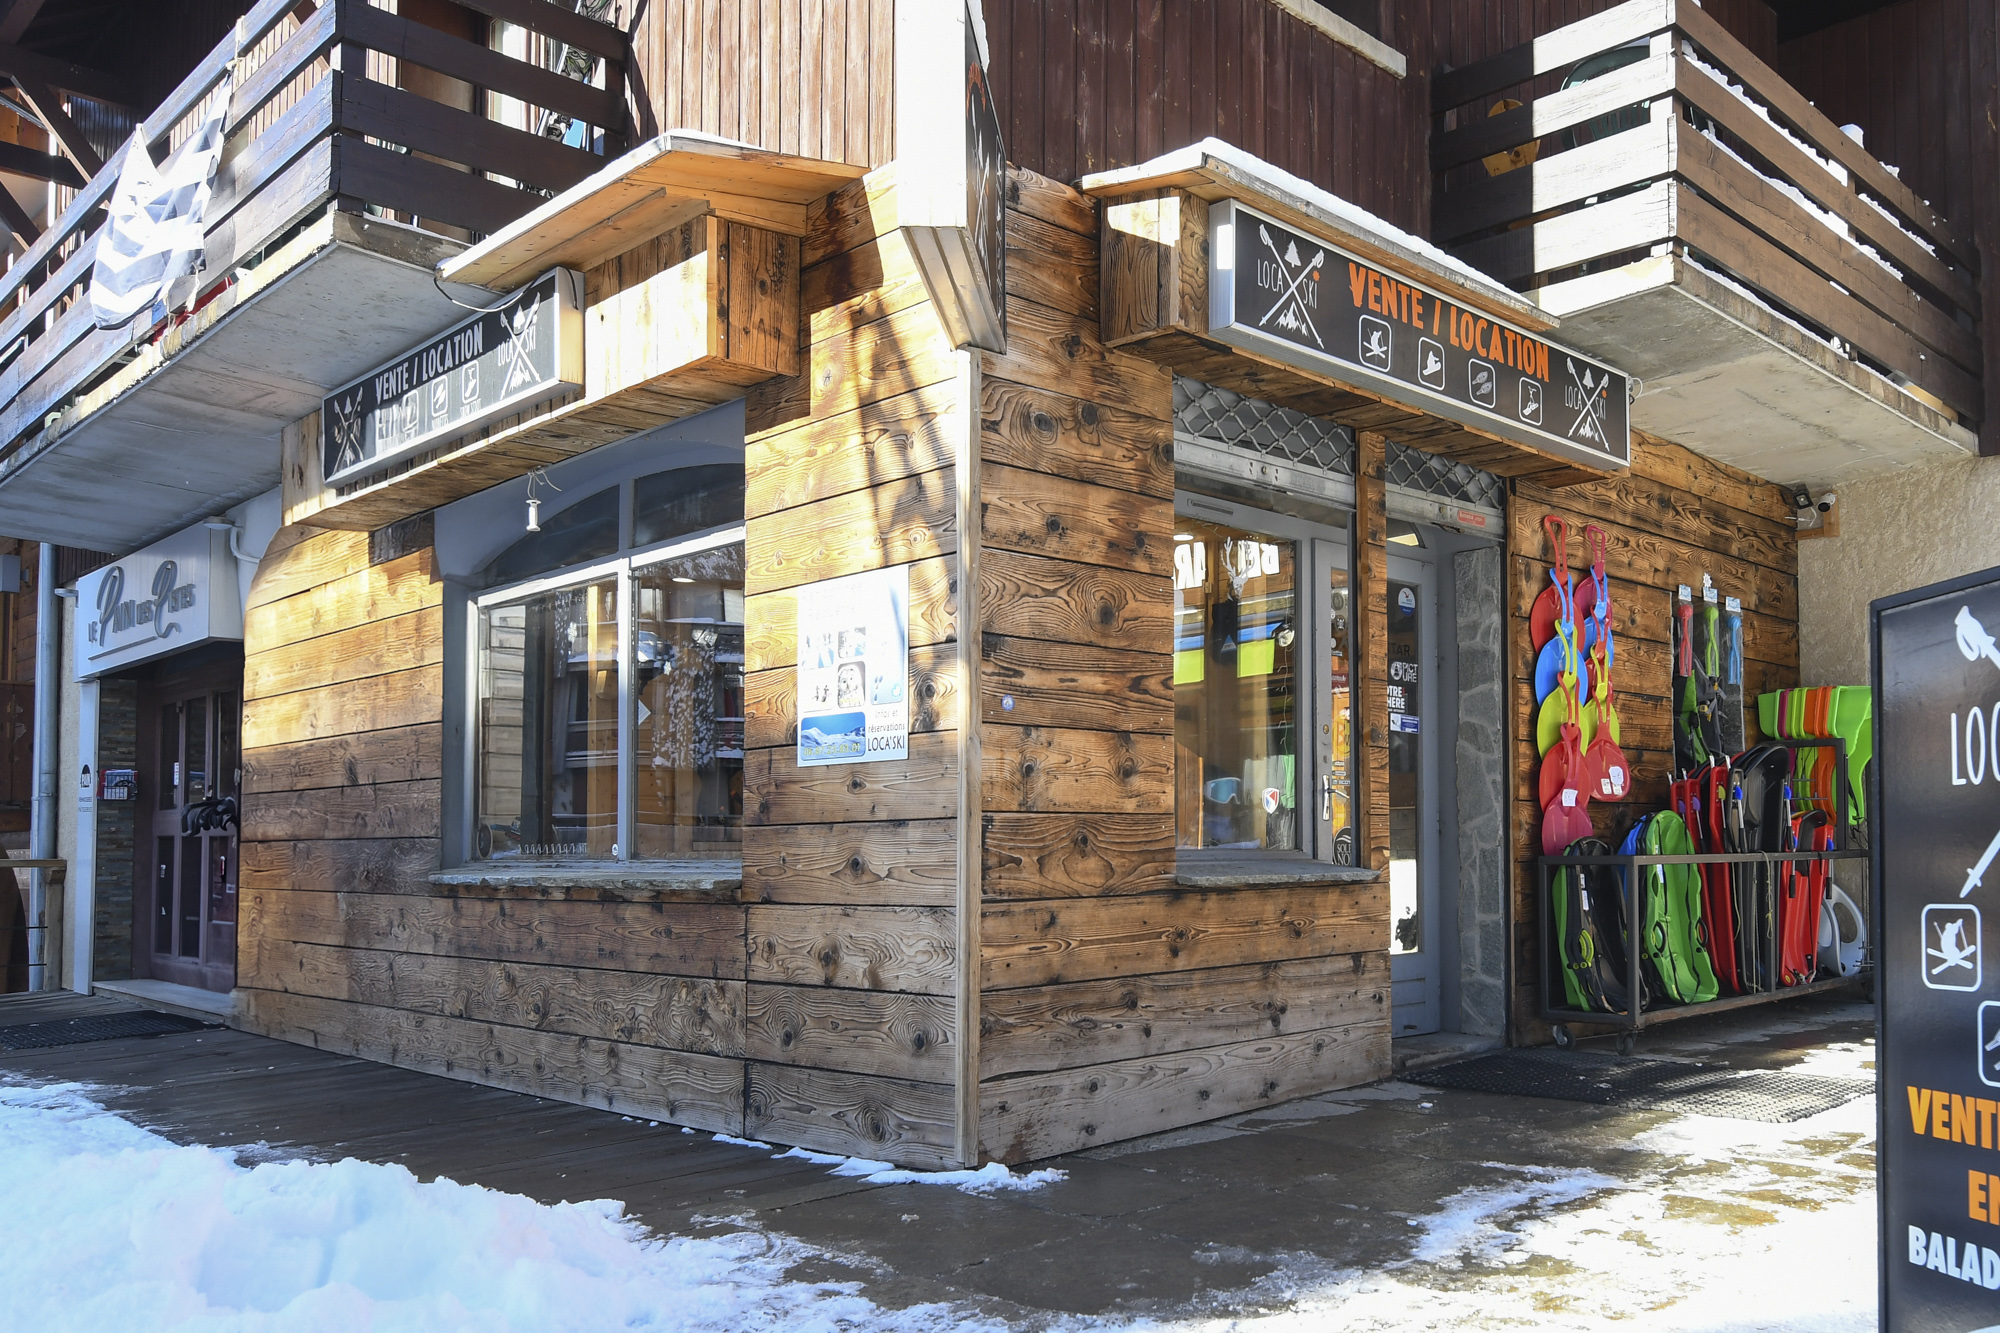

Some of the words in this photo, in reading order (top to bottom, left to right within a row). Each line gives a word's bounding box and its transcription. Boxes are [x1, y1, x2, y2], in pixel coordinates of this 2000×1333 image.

[1257, 258, 1284, 294] LOCA
[1302, 278, 1318, 310] SKI
[1349, 262, 1424, 330] VENTE
[1432, 299, 1442, 336] /
[1449, 306, 1550, 383] LOCATION
[525, 325, 536, 353] SKI
[375, 362, 409, 405] VENTE
[413, 357, 419, 386] /
[422, 321, 483, 382] LOCATION
[1564, 384, 1583, 411] LOCA
[1595, 396, 1606, 420] SKI
[88, 620, 98, 643] LE
[1402, 662, 1418, 673] PICT
[1402, 672, 1417, 683] URE
[868, 721, 905, 733] réservations
[868, 735, 905, 752] LOCA'SKI
[1907, 1085, 2000, 1151] VENT
